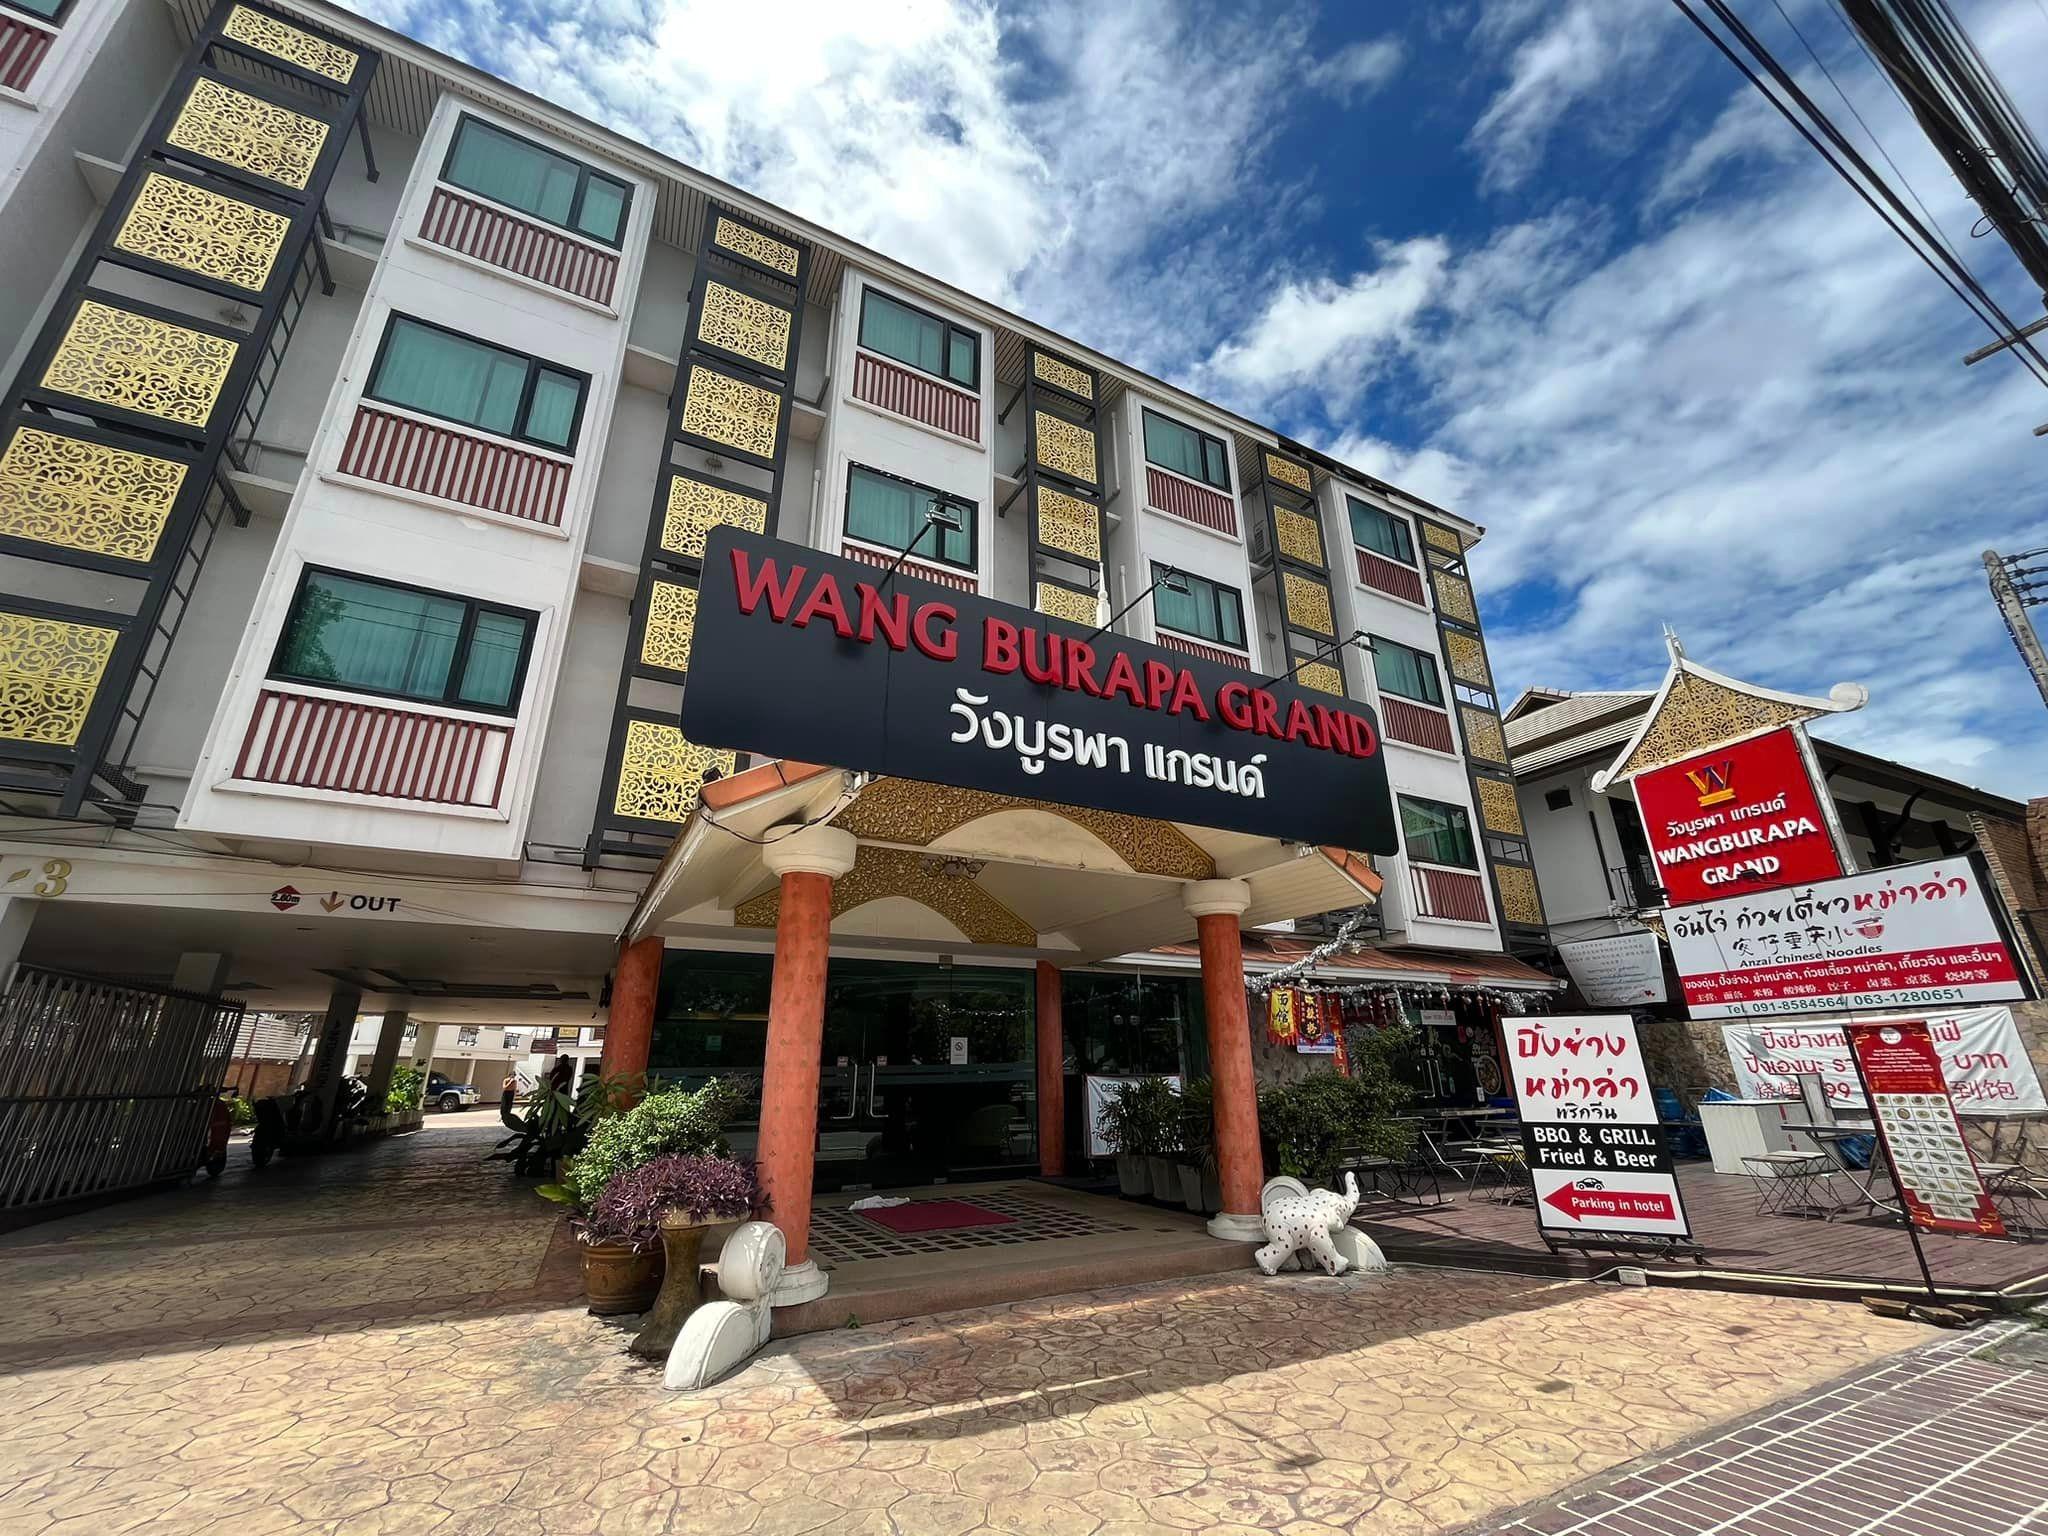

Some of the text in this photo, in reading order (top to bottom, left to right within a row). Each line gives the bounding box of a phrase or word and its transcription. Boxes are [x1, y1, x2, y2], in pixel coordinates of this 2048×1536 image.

[730, 548, 1379, 760] WANG BURAPA GRAND
[950, 687, 1268, 800] วังบูรพา แกรนด์
[1666, 791, 1787, 837] วังบูรพา แกรนด์
[1656, 816, 1818, 866] WANGBURAPA
[1701, 855, 1780, 886] GRAND
[350, 894, 401, 912] OUT
[1739, 943, 1882, 968] Anzai Chinese Noodles
[1854, 988, 1965, 1006] 063-1280651
[1525, 1067, 1640, 1100] หม่าล่า
[1533, 1126, 1657, 1146] BBQ & GRILL
[1540, 1148, 1659, 1168] Fried & Beer
[1571, 1196, 1665, 1213] Parking in hotel
